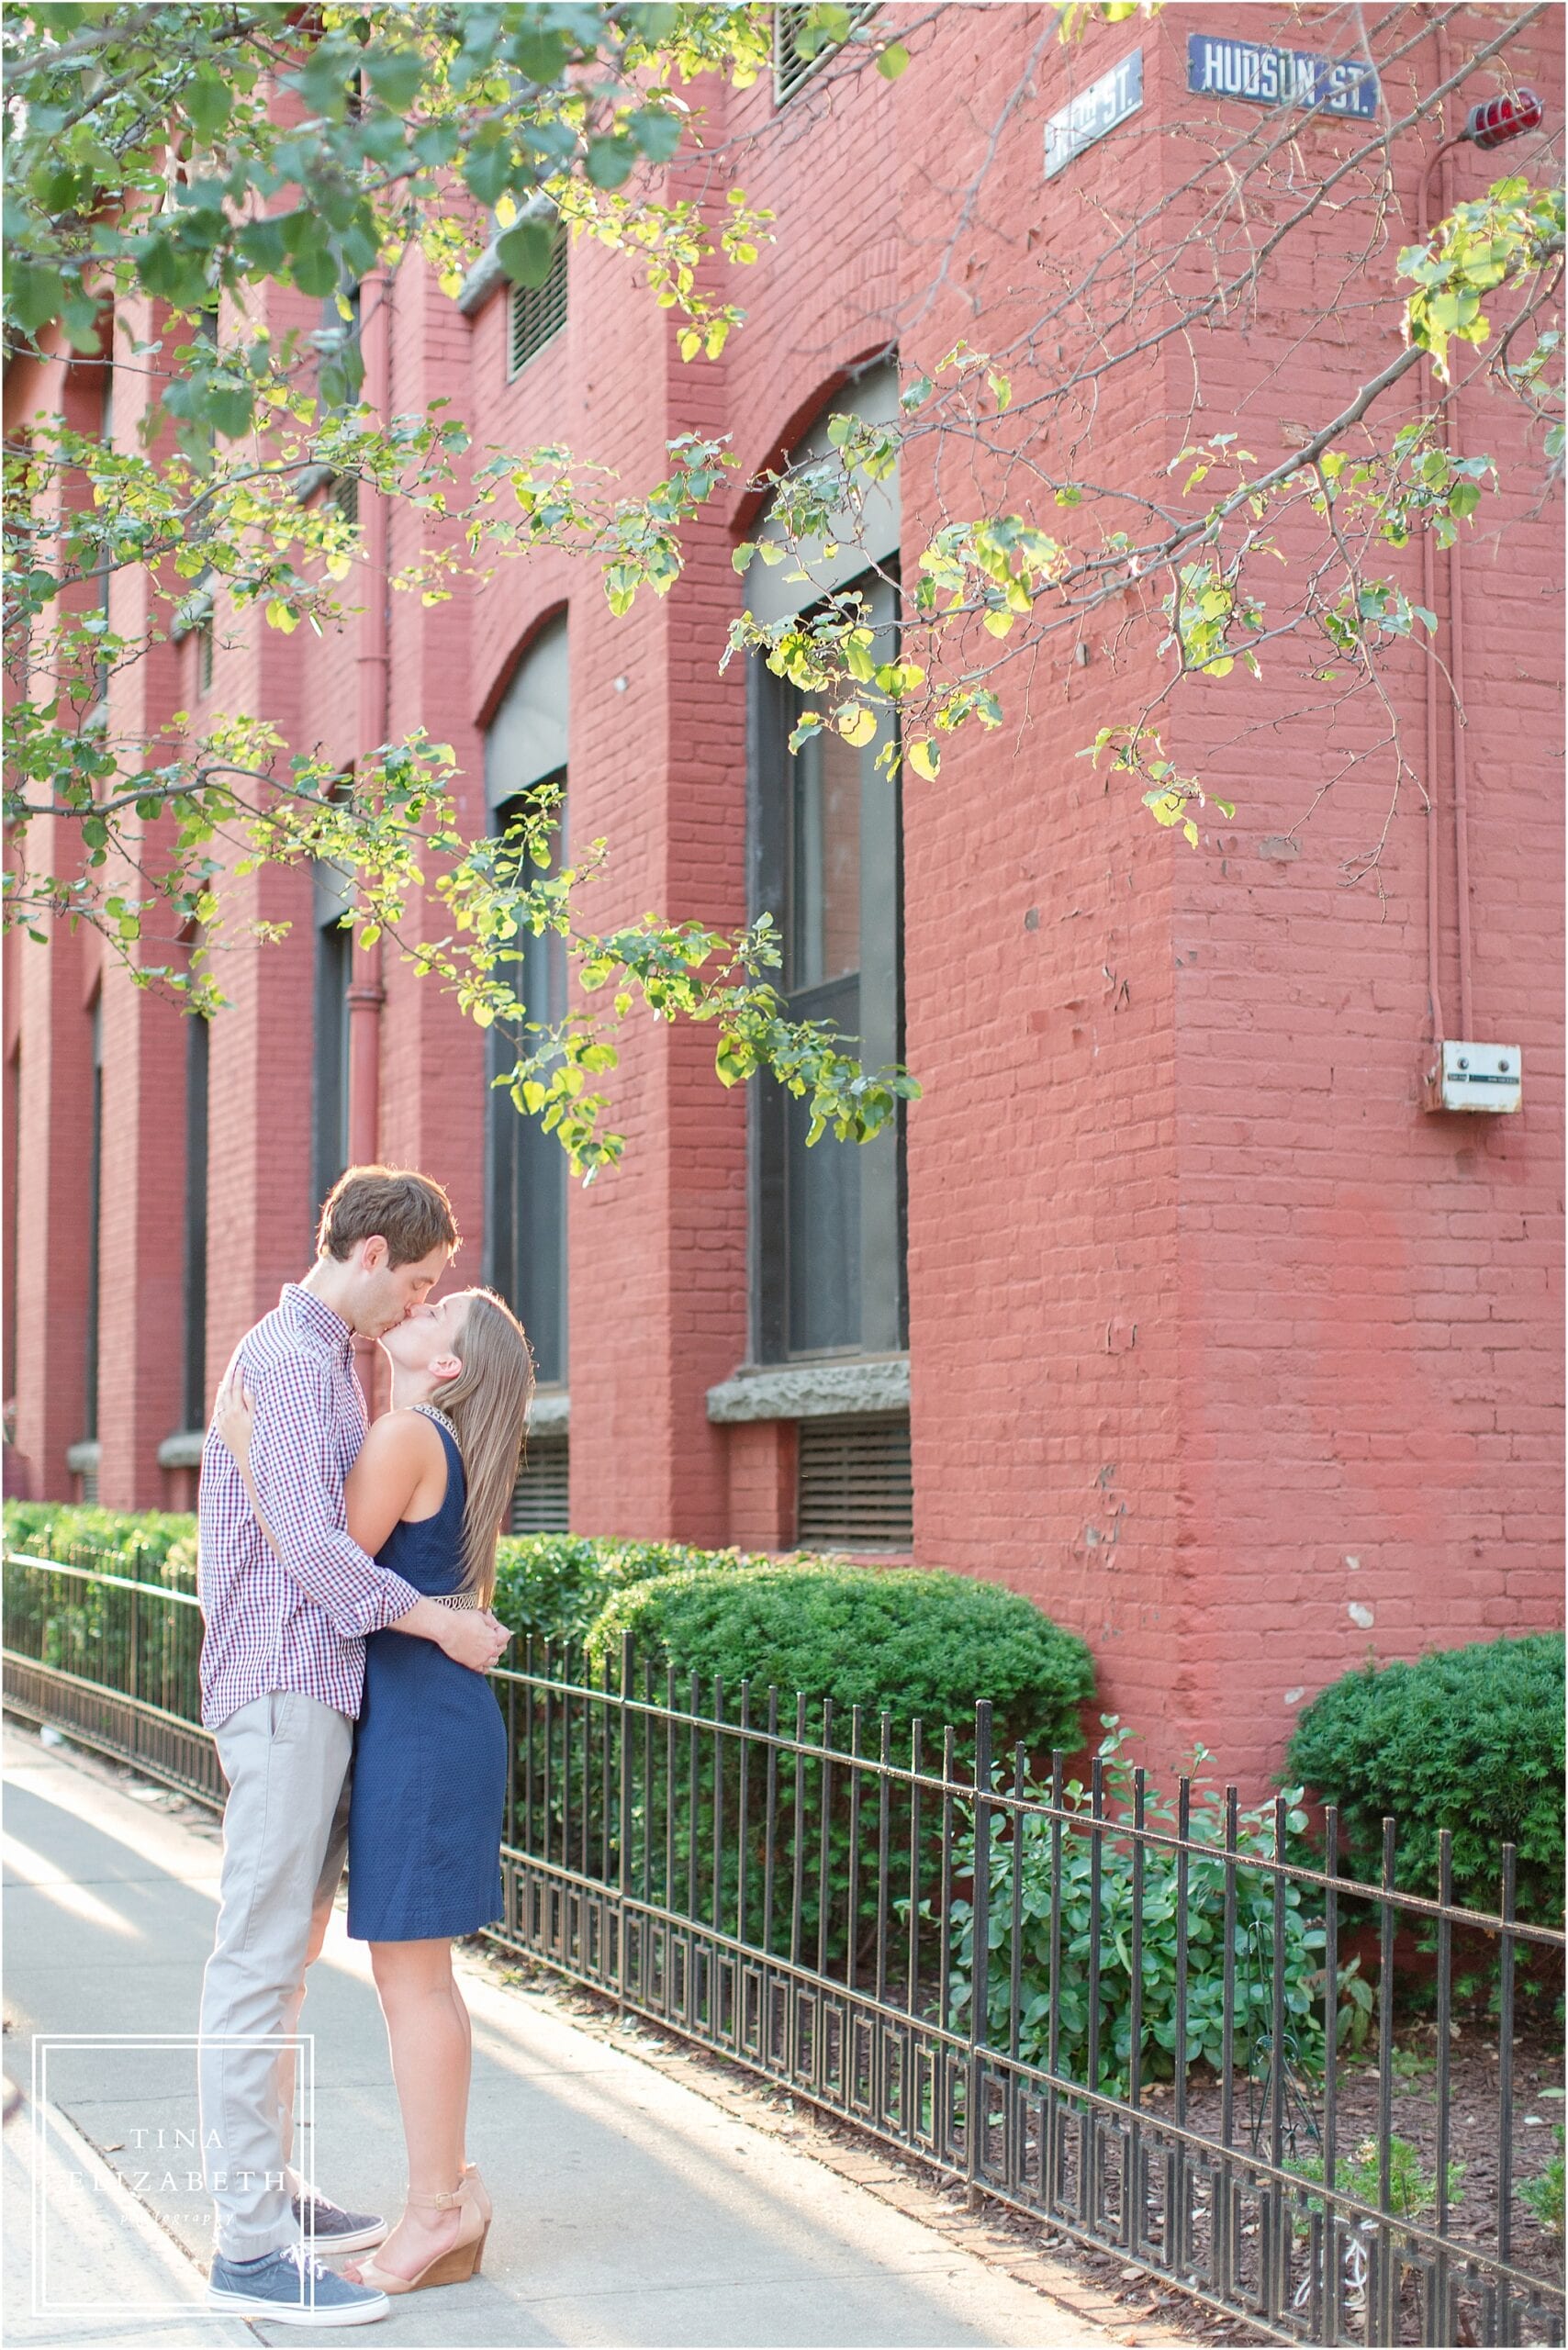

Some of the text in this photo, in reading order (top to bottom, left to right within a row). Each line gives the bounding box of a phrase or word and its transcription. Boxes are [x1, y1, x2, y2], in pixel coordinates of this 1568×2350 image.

[1103, 63, 1133, 124] ST.
[1204, 43, 1369, 114] HUDSON ST.
